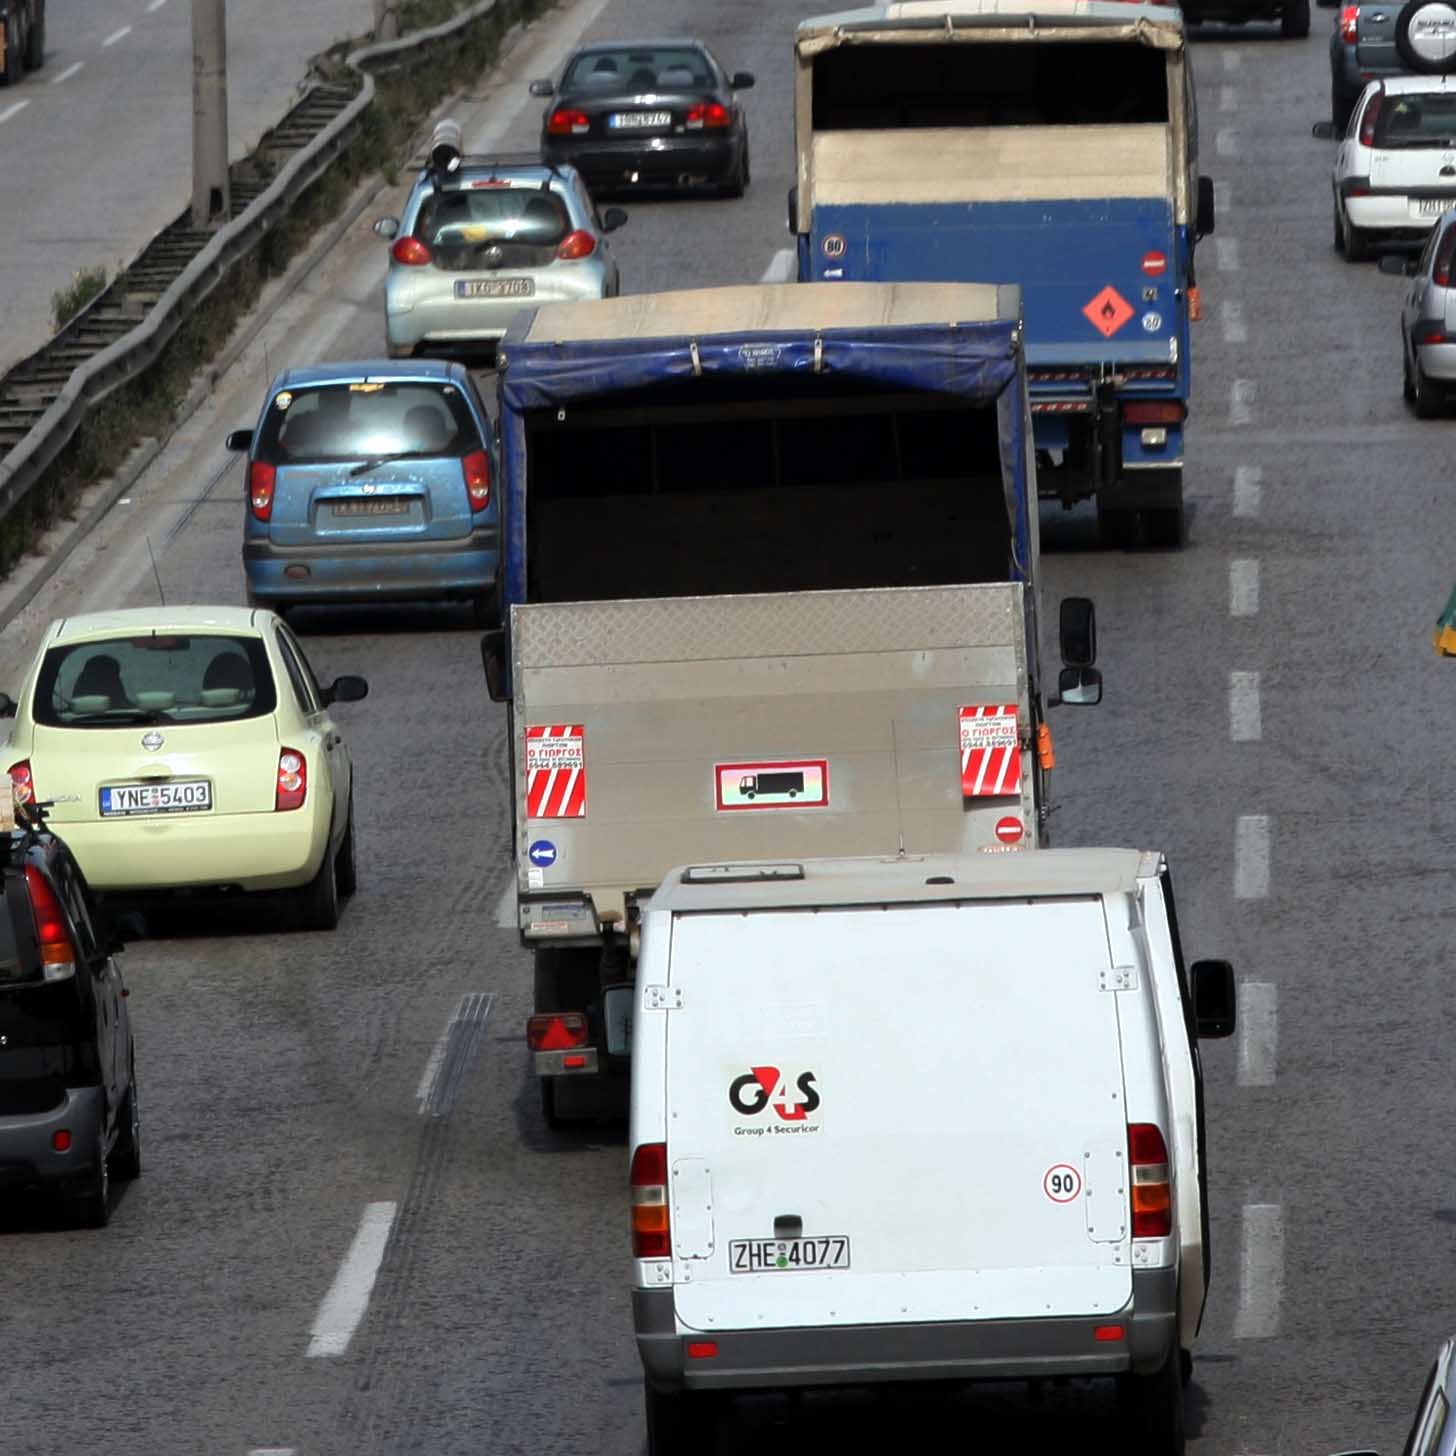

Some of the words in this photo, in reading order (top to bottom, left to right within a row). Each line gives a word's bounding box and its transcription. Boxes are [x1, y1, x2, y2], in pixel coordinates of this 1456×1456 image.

[117, 788, 151, 808] YNE
[160, 783, 207, 805] 5403
[728, 1066, 821, 1121] G4S
[734, 1126, 765, 1137] Group
[767, 1125, 773, 1134] 4
[774, 1123, 820, 1135] Securicor
[1051, 1174, 1074, 1194] 90
[733, 1242, 776, 1270] ZHE
[789, 1240, 846, 1266] 4077
